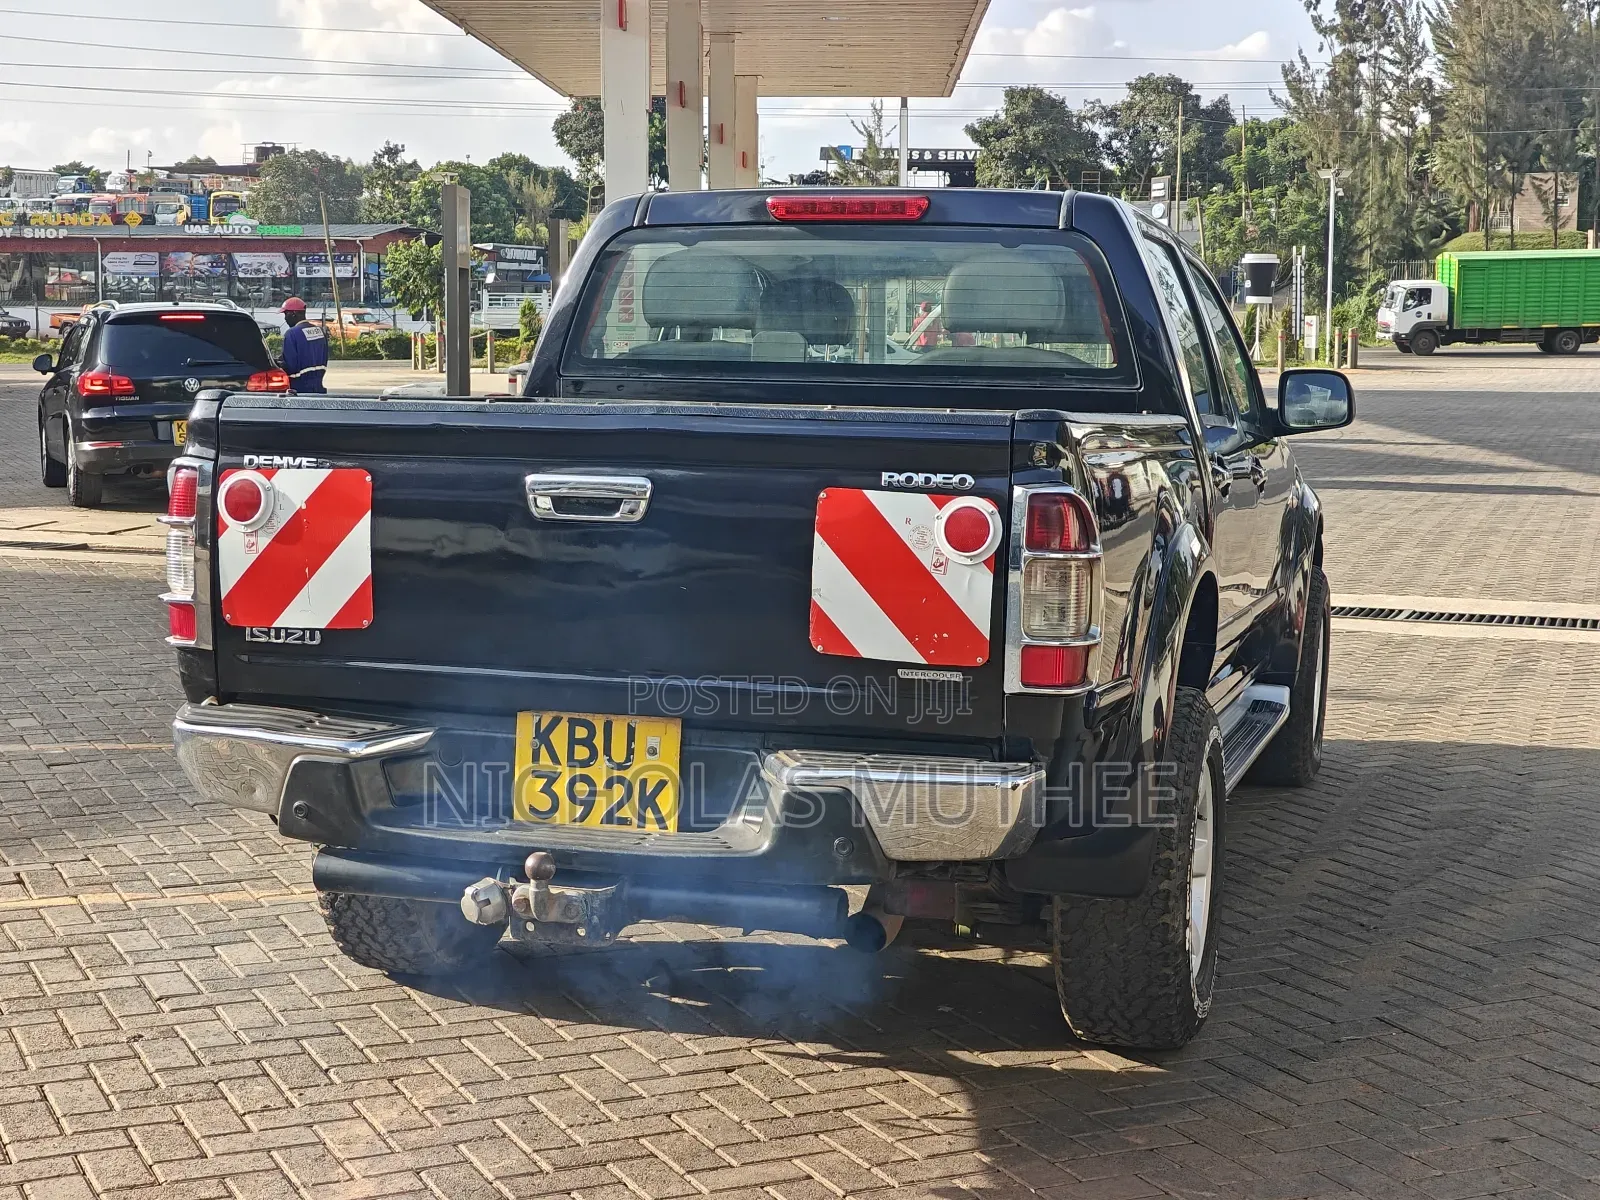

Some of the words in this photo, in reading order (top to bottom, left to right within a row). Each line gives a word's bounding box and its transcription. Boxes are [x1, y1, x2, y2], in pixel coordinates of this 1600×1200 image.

[879, 150, 920, 160] SALS
[924, 151, 933, 160] &
[938, 151, 981, 160] SERVI
[30, 213, 113, 226] RUNDA
[23, 228, 68, 239] SHOP
[185, 224, 209, 234] UAE
[214, 224, 252, 234] AUTO
[256, 225, 303, 235] SPARES
[177, 422, 185, 432] K
[178, 433, 186, 443] 5
[881, 471, 975, 490] RODEO
[905, 517, 912, 526] R
[245, 627, 322, 645] ISUZU
[900, 671, 962, 680] INTERCOOLER
[531, 715, 637, 771] KBU
[528, 769, 669, 831] 392K
